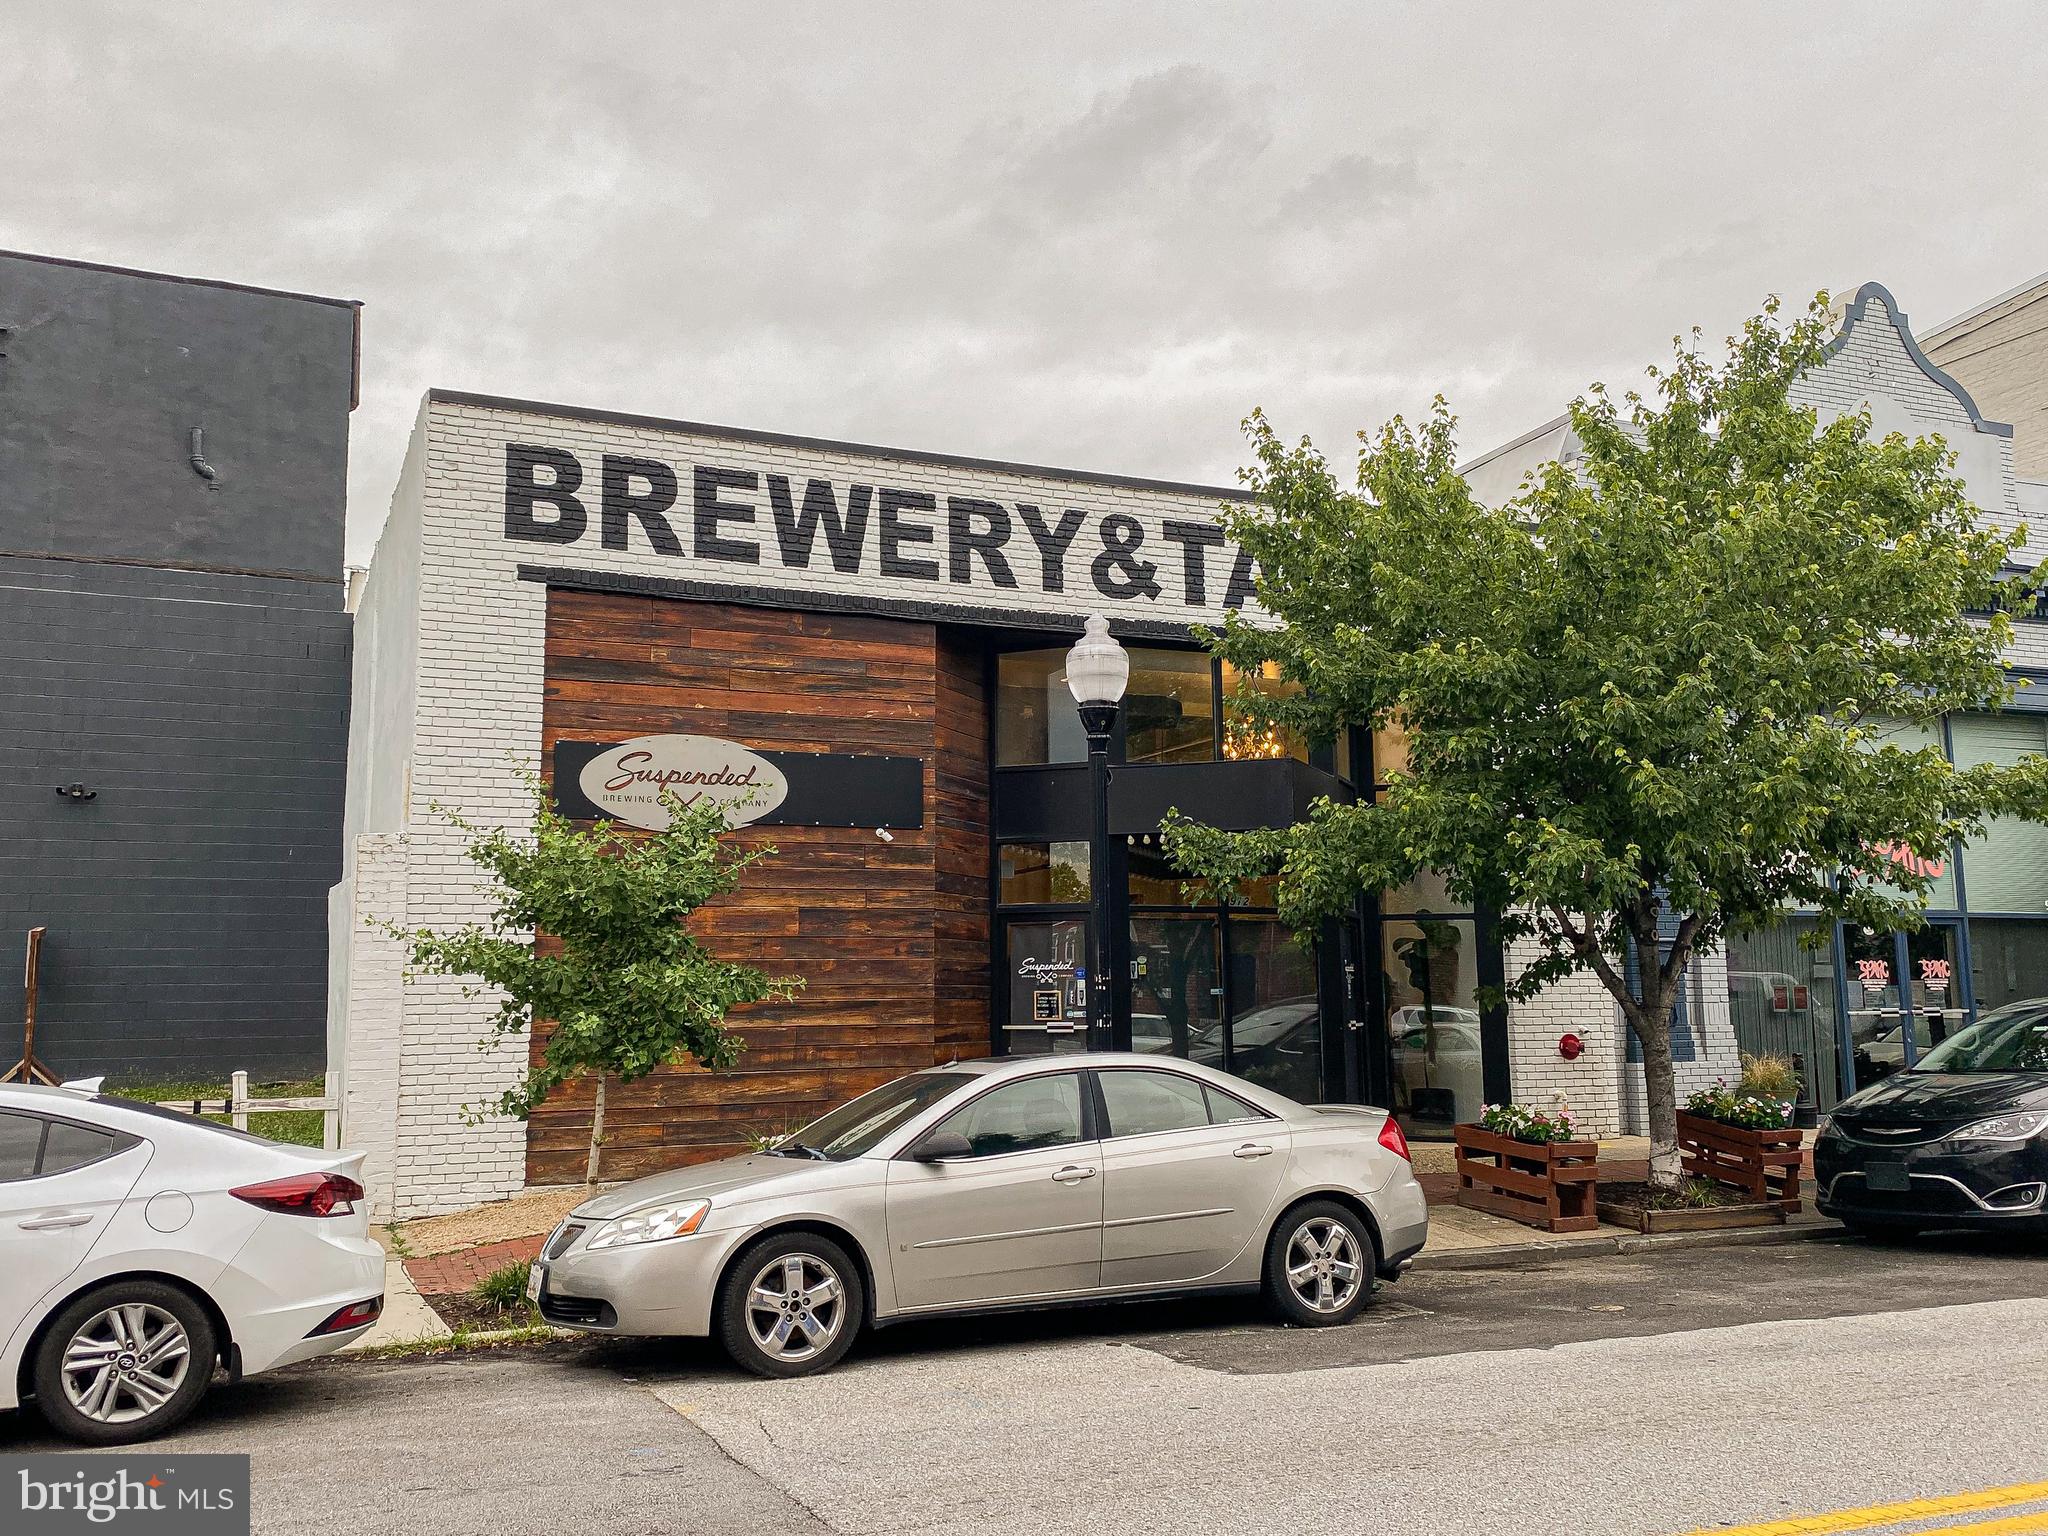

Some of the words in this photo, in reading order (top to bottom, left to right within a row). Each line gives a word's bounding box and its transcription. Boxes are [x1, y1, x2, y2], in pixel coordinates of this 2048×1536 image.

[604, 751, 761, 792] Suspended
[602, 794, 653, 804] BREWING
[1018, 957, 1074, 974] Suspended
